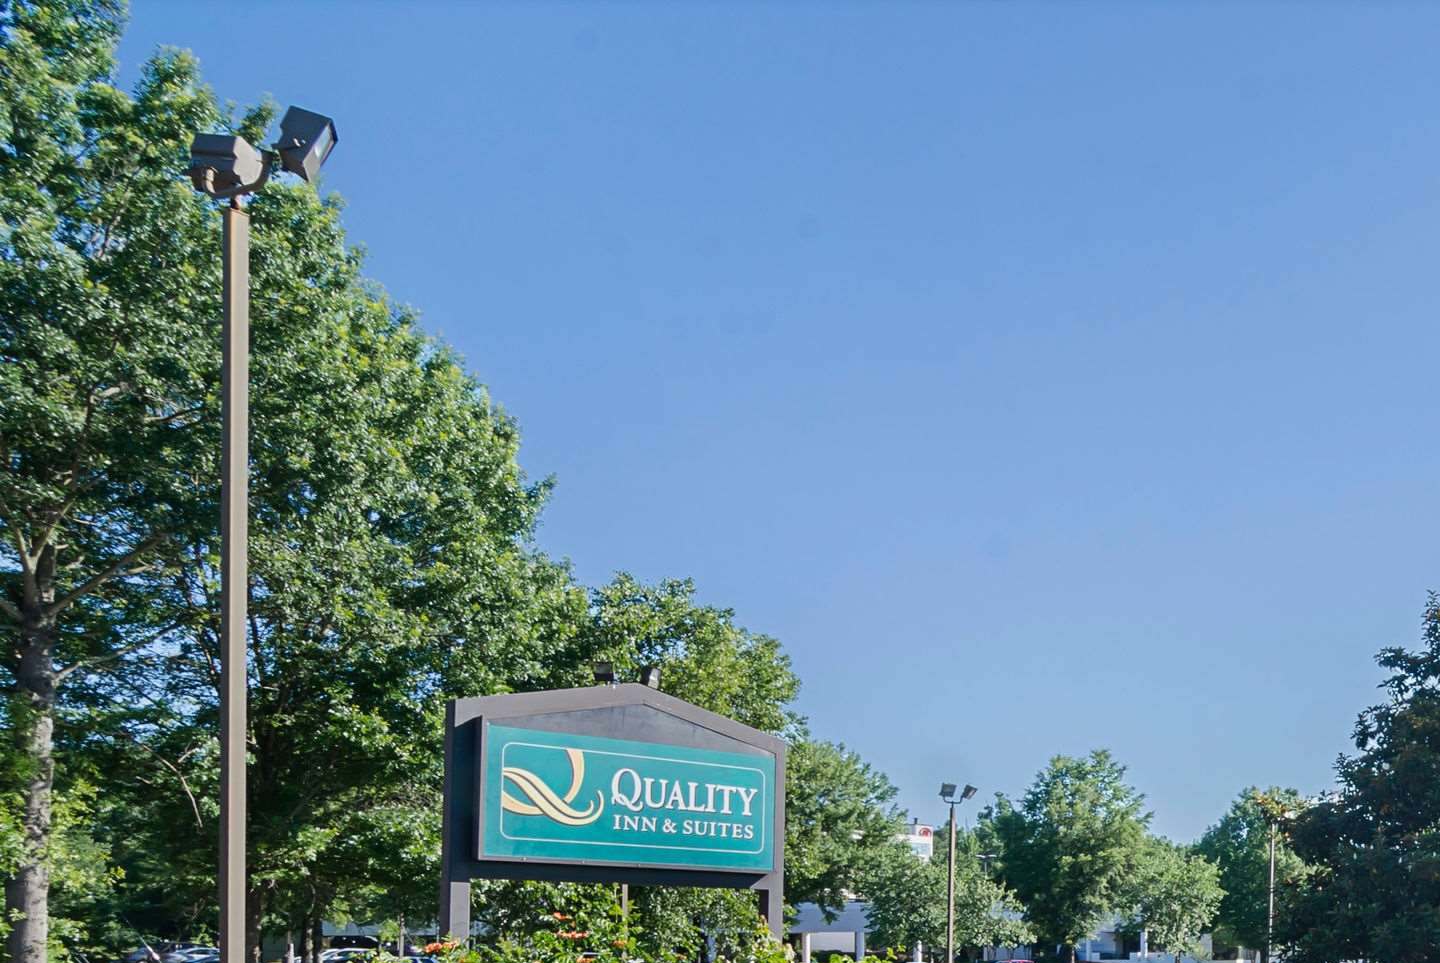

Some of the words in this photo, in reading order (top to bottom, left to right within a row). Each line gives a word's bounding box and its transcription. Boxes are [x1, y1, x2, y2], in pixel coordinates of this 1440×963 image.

[611, 768, 758, 816] QUALITY
[613, 814, 657, 832] INN
[662, 818, 677, 834] &
[682, 819, 754, 839] SUITES
